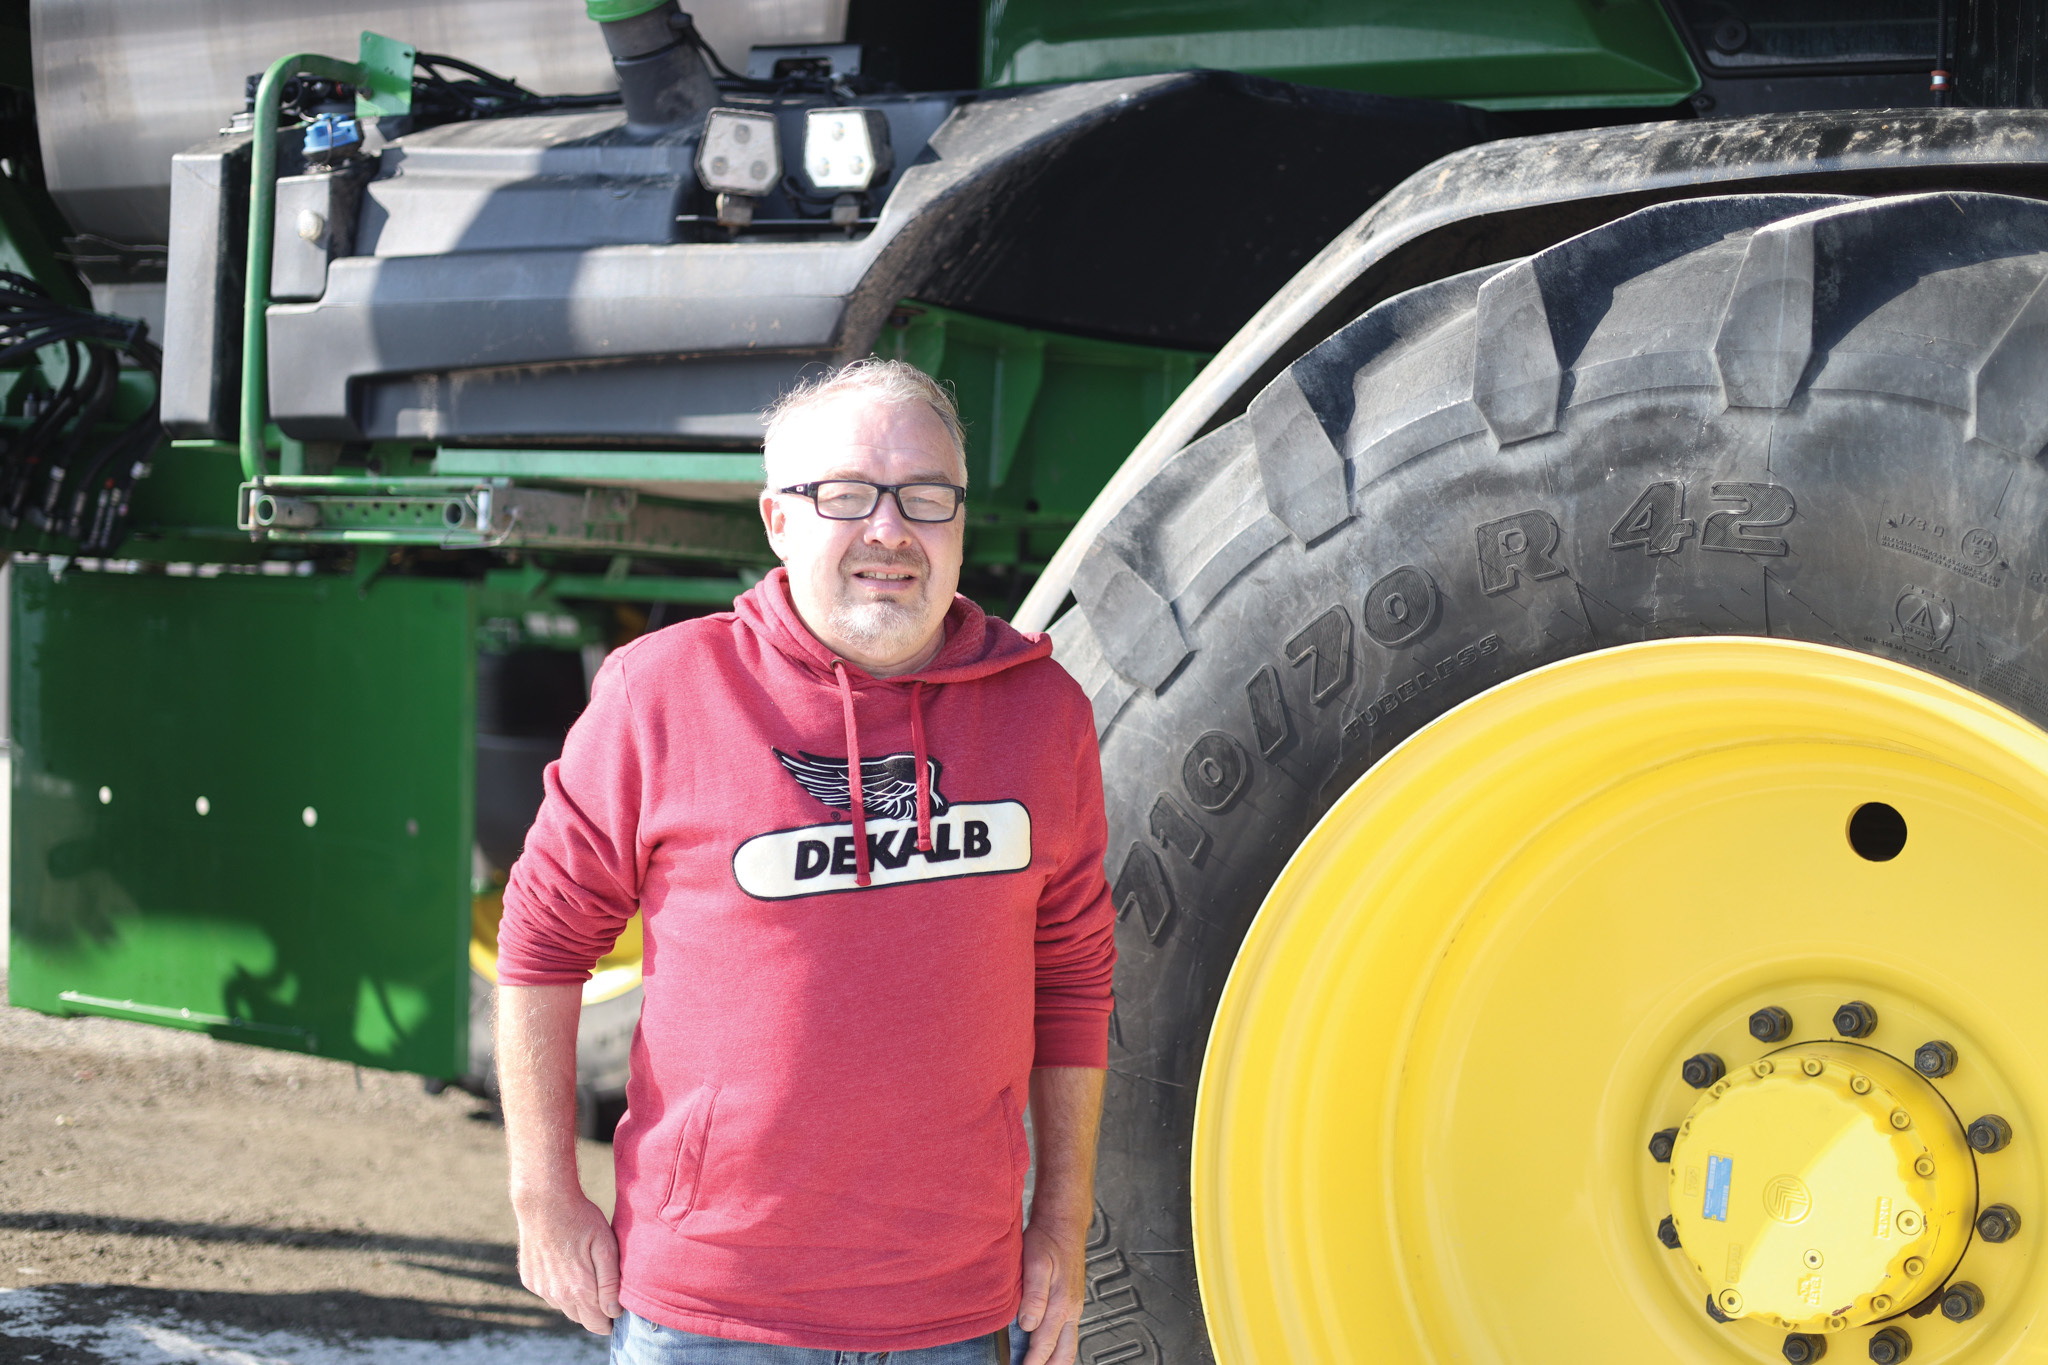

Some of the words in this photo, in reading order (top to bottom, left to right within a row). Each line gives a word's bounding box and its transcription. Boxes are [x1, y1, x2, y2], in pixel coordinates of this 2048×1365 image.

[1112, 564, 1437, 944] 710/70
[1474, 508, 1568, 595] R
[1607, 479, 1797, 557] 42
[1343, 633, 1500, 740] TUBELESS
[794, 820, 992, 881] DEKALB
